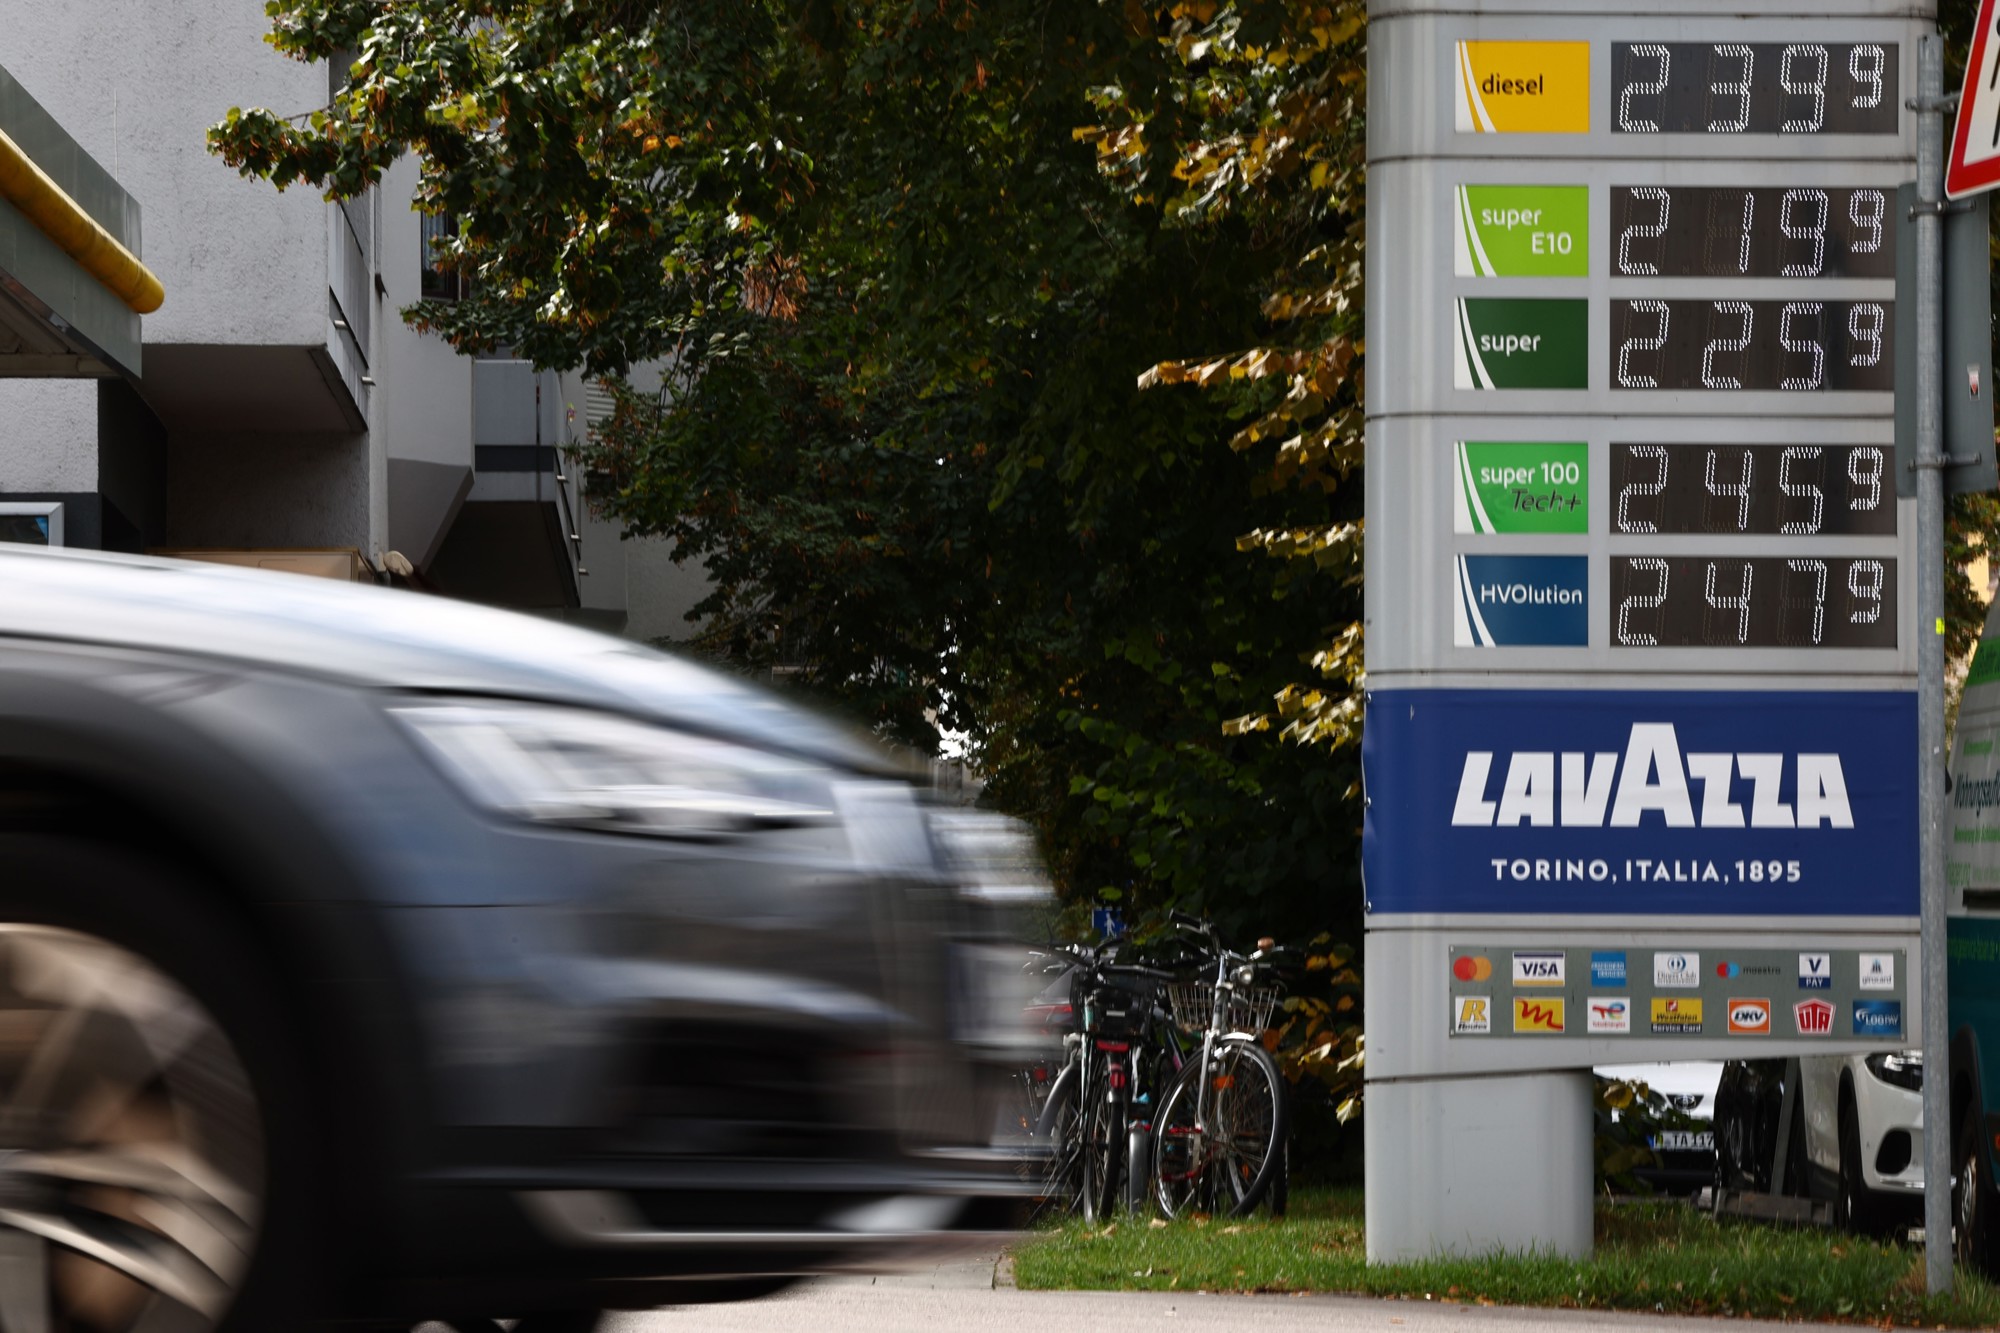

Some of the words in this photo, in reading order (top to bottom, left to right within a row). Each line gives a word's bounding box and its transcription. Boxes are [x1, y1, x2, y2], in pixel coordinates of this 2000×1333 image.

[1482, 74, 1543, 95] diesel
[1482, 208, 1542, 231] super
[1531, 232, 1572, 255] E10
[1480, 334, 1541, 357] super
[1480, 466, 1535, 489] super
[1541, 462, 1579, 484] 100
[1512, 488, 1582, 512] Tech+
[1481, 584, 1583, 604] HVOlution
[1451, 722, 1854, 829] LAVAZZA
[1735, 861, 1801, 883] 1895
[1522, 963, 1558, 976] VISA
[1743, 966, 1780, 975] maestro
[1808, 958, 1822, 973] V
[1805, 977, 1824, 988] PAY
[1861, 975, 1892, 985] girocard
[1656, 1014, 1698, 1022] Westfalen
[1734, 1012, 1763, 1022] DKV
[1799, 1003, 1832, 1032] UTA
[1683, 1024, 1701, 1033] Card
